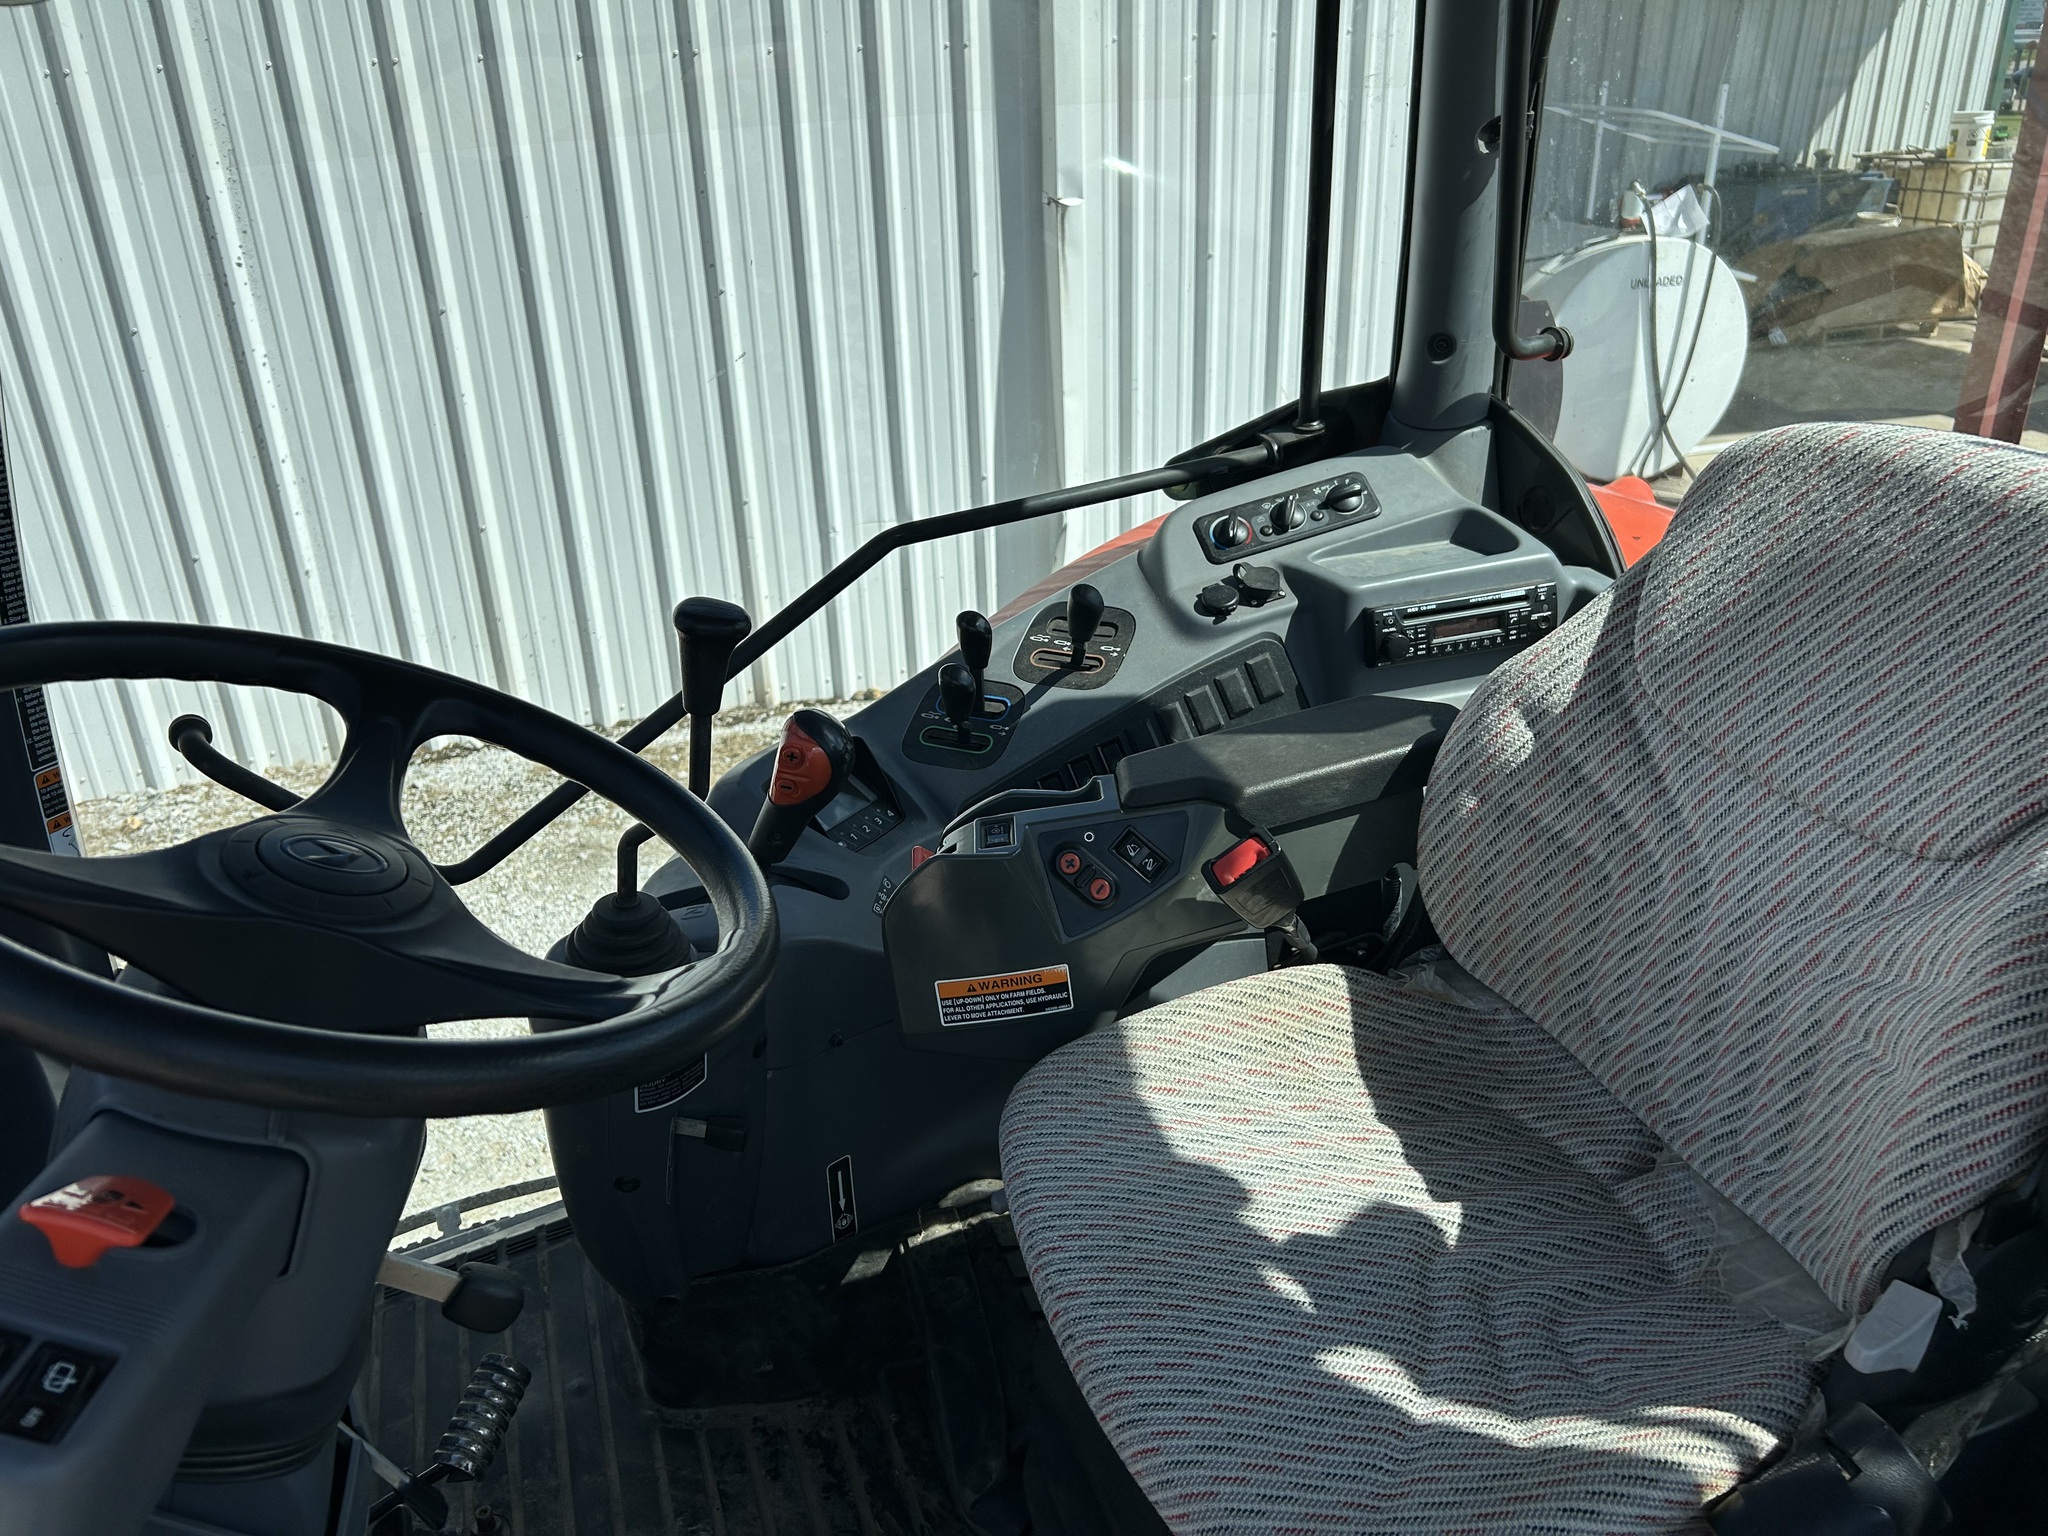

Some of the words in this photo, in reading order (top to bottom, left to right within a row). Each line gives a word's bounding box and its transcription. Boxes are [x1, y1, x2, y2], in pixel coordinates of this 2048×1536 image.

[1630, 274, 1683, 290] UNLADED
[978, 974, 1042, 990] WARNING
[1038, 992, 1068, 1002] HYDRAULIC
